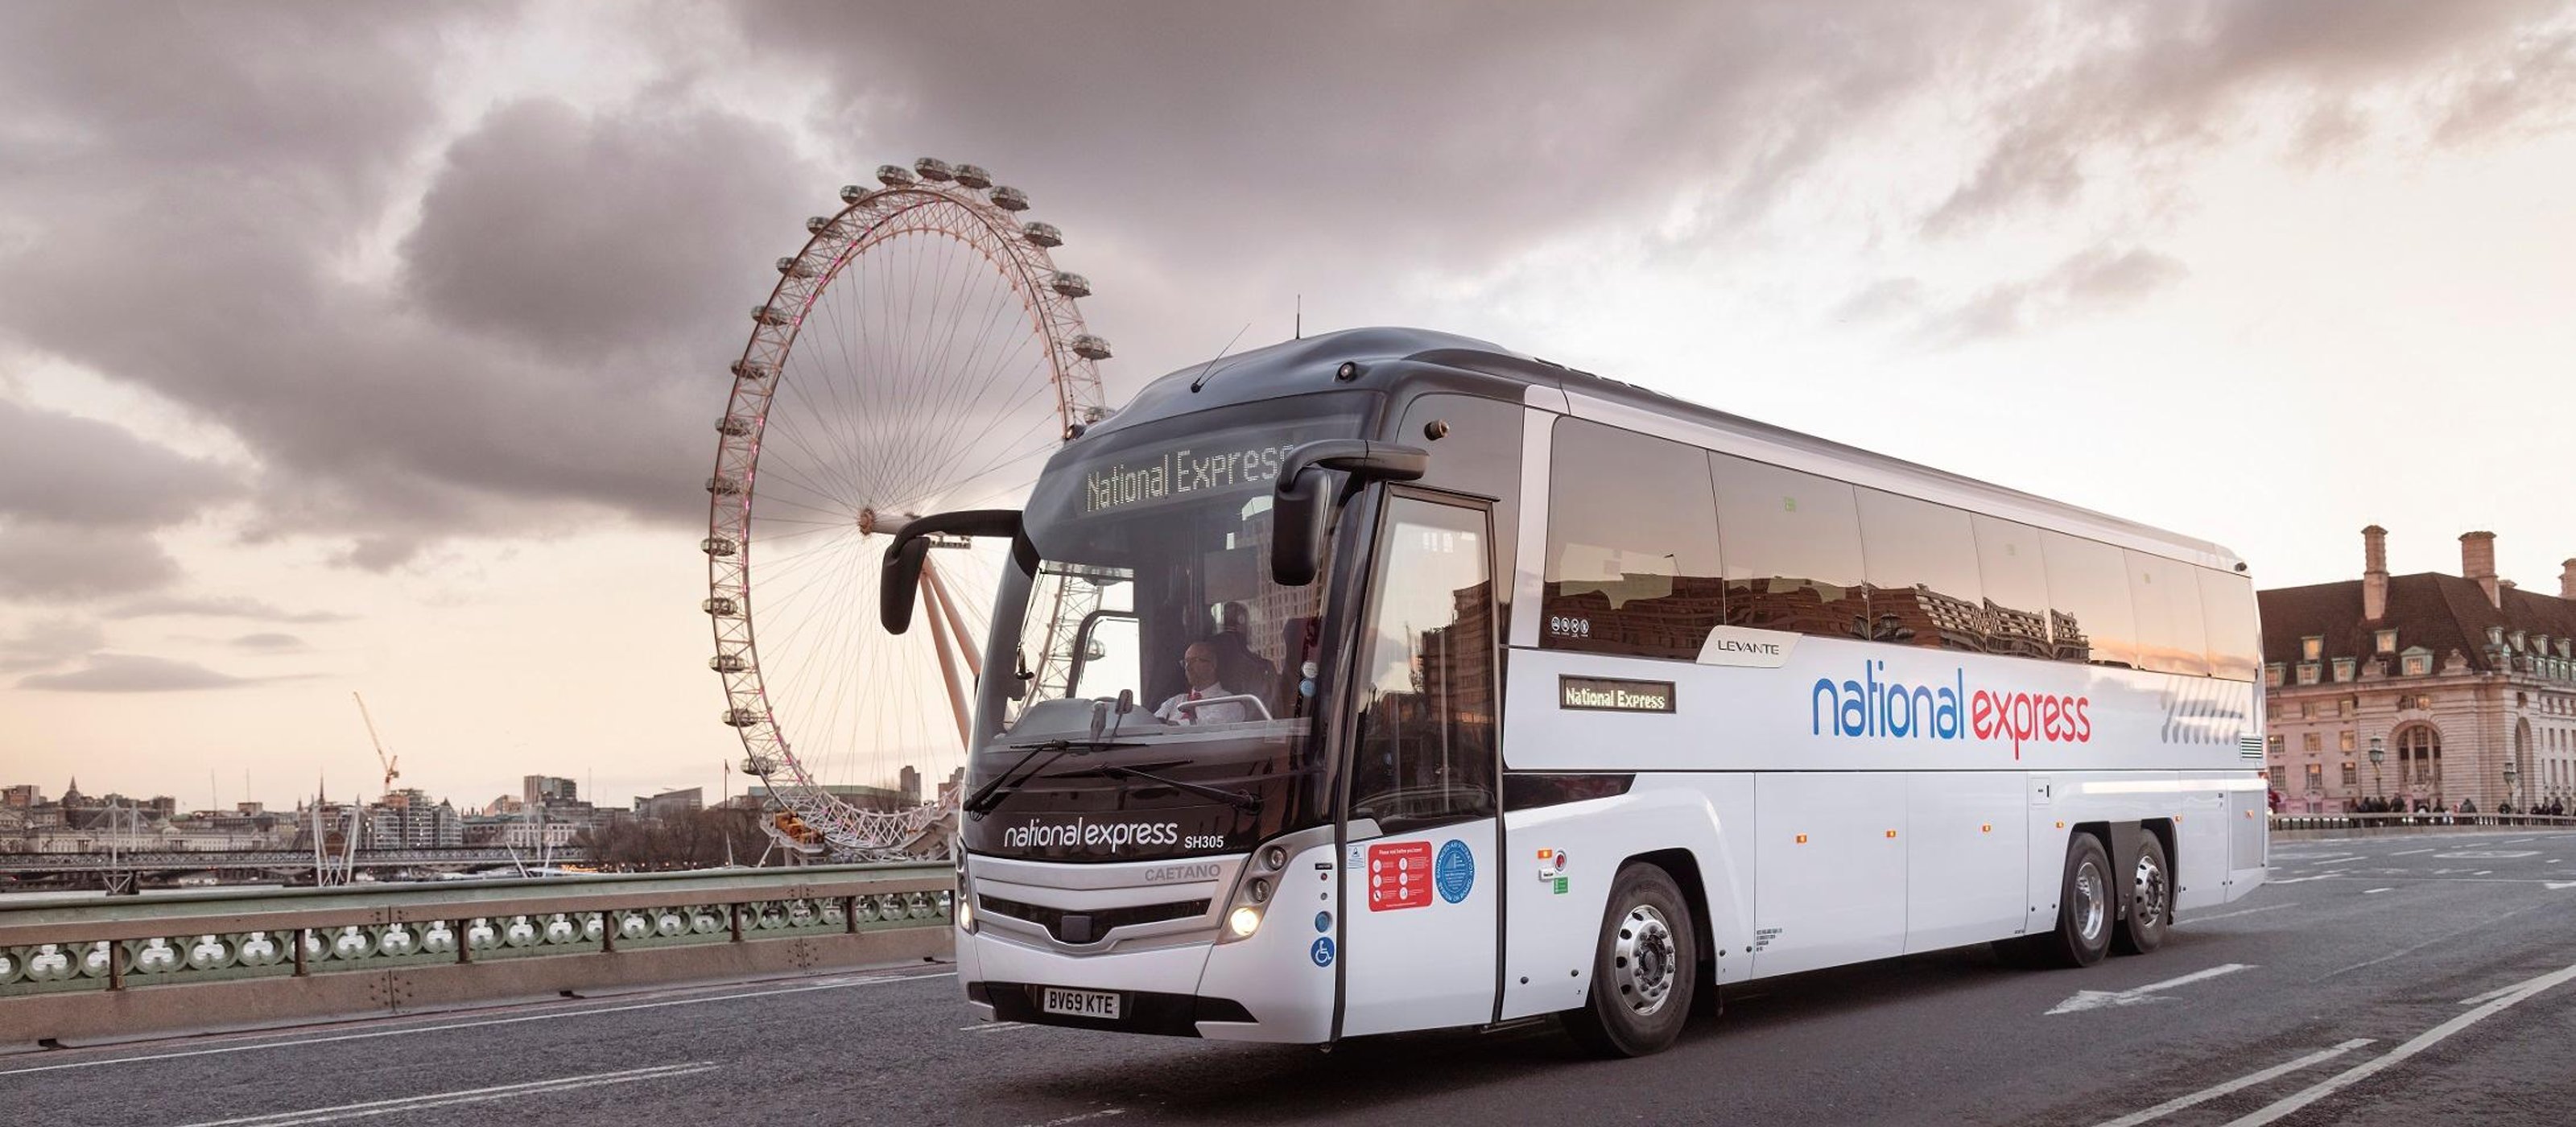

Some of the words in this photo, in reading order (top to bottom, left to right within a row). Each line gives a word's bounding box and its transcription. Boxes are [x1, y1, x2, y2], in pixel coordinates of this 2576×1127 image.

[1087, 454, 1168, 512] National
[1717, 640, 1780, 655] LEVANTE
[1566, 687, 1614, 707] National
[1617, 690, 1666, 709] Express
[1813, 659, 1964, 740] national
[1971, 689, 2091, 760] express
[1004, 817, 1083, 847] national
[1085, 823, 1178, 853] express
[1184, 836, 1224, 848] SH305
[1145, 864, 1221, 881] CAETANO
[1049, 991, 1083, 1011] BV69
[1086, 994, 1113, 1014] KTE
